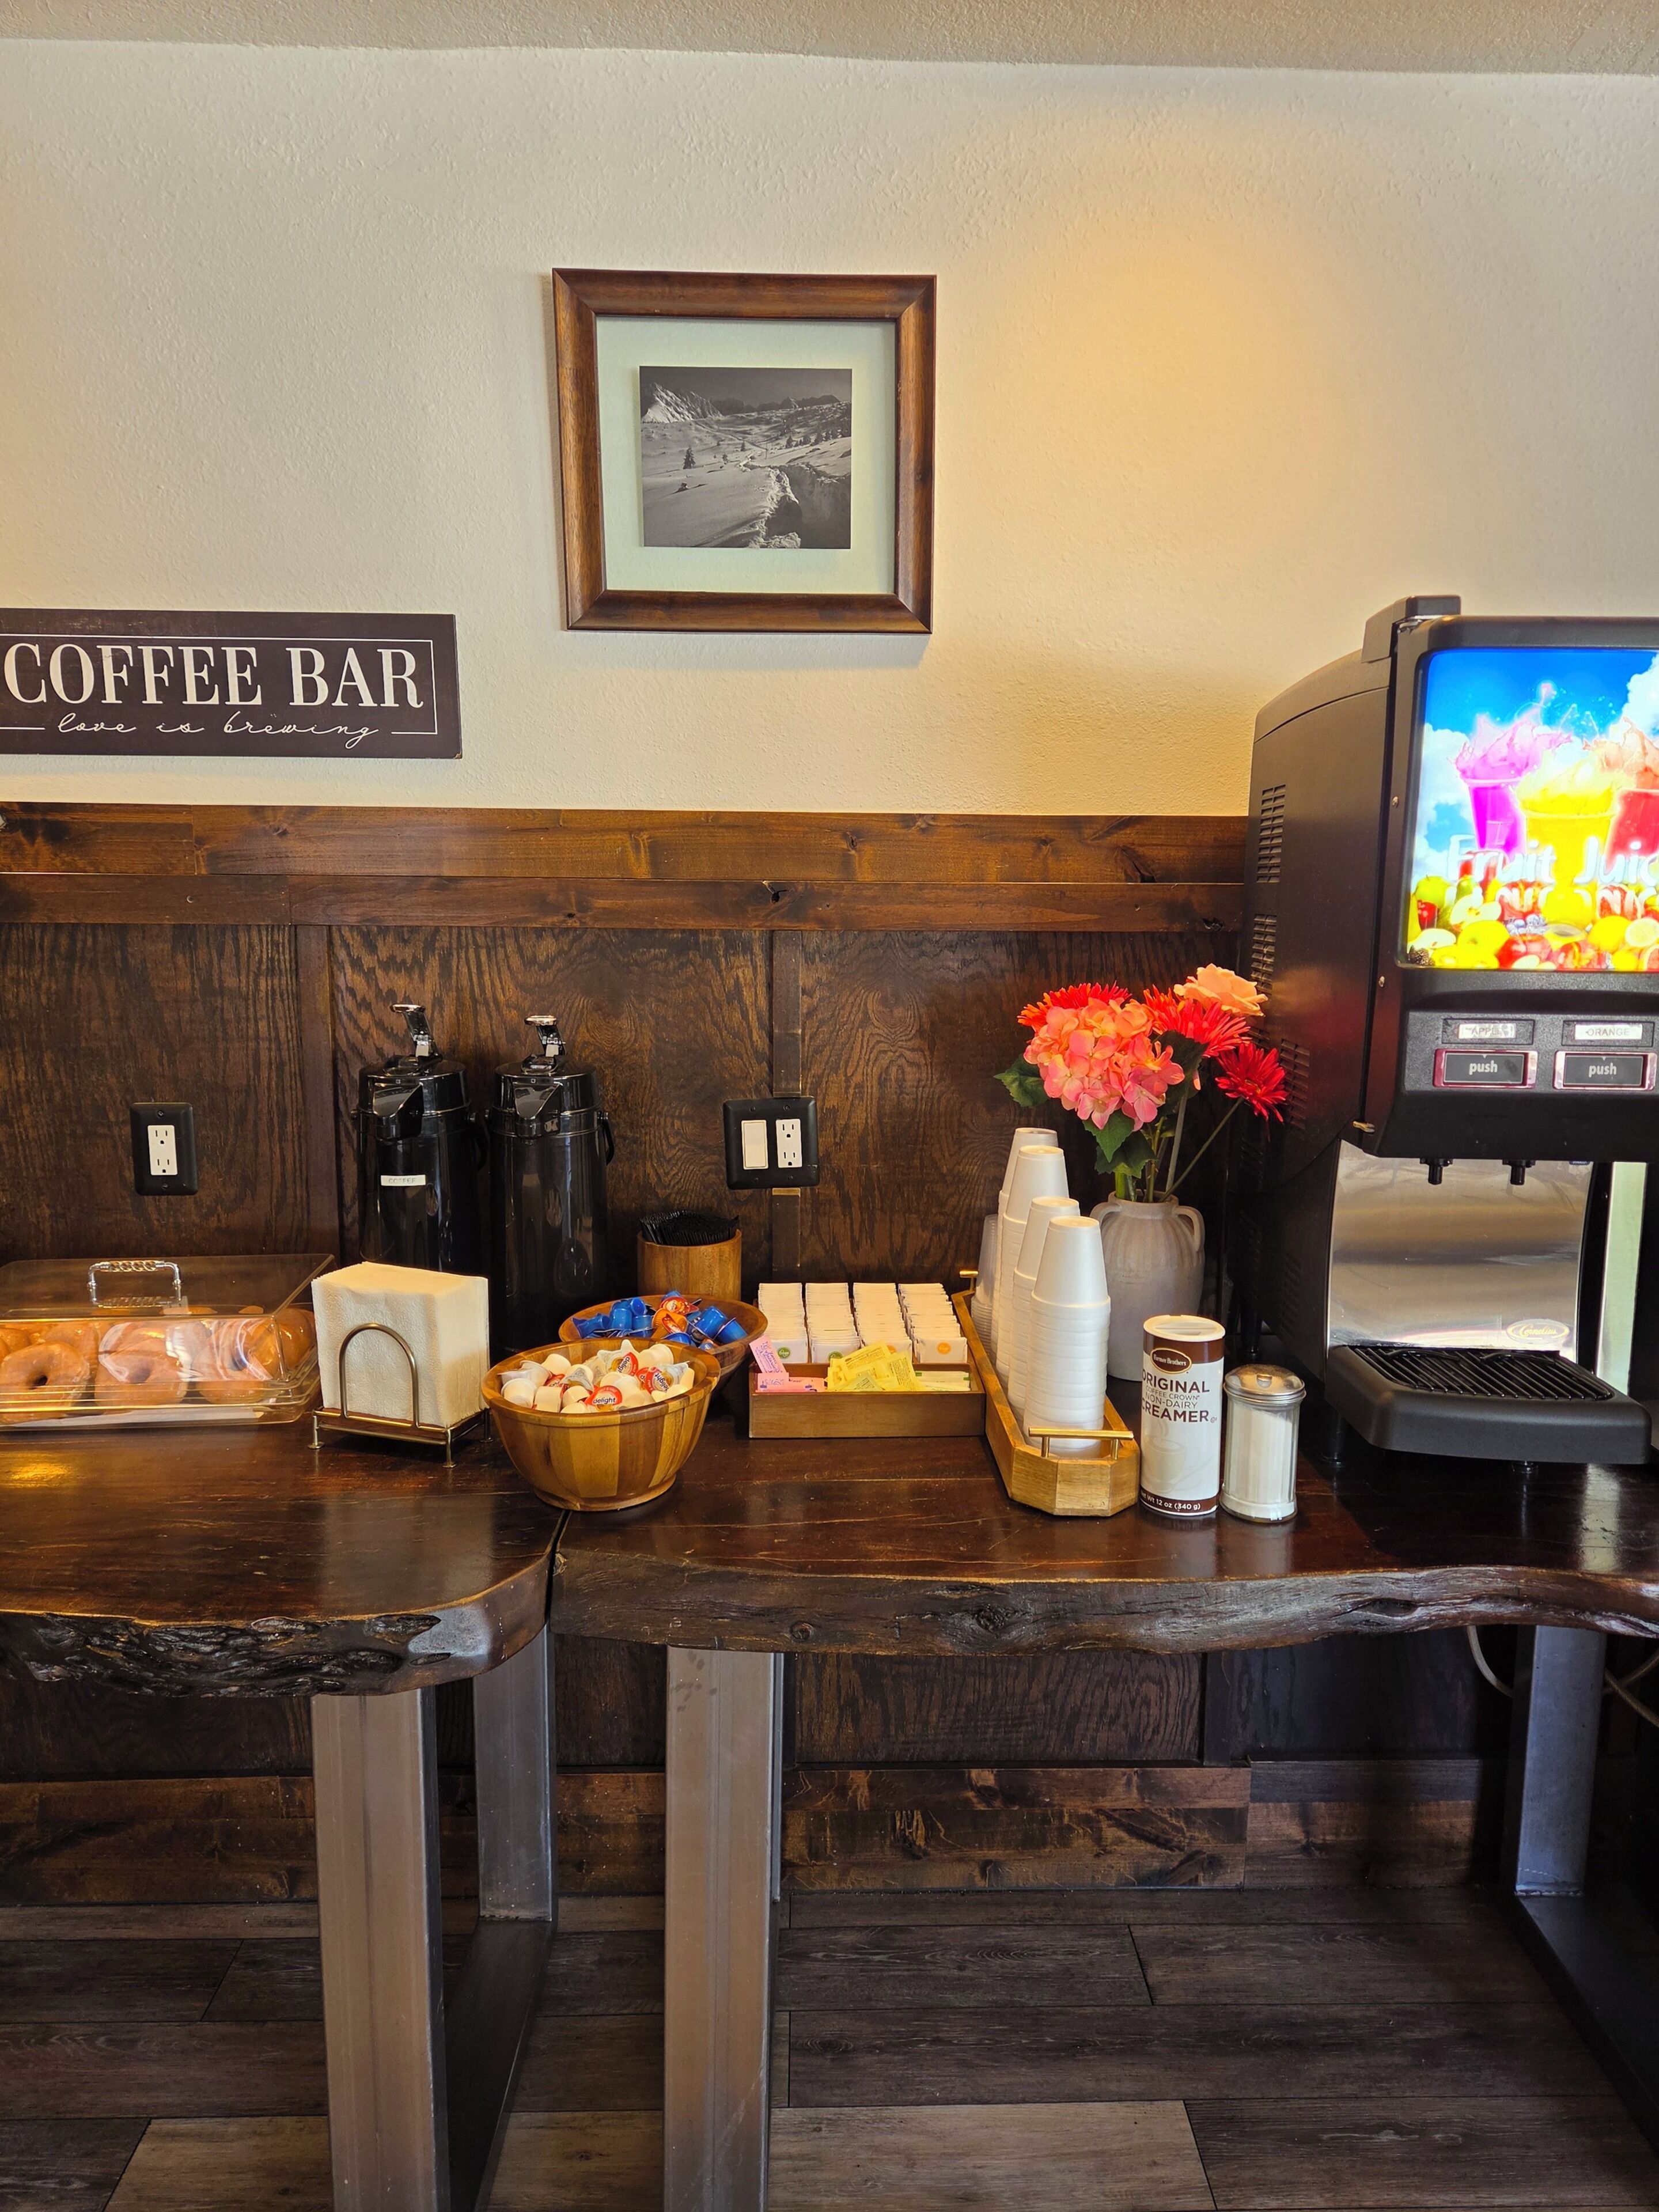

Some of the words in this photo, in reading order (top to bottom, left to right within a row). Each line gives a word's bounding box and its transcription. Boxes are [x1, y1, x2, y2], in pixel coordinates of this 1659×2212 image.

[3, 642, 263, 707] COFFEE
[285, 646, 424, 709] BAR
[58, 712, 137, 734] love
[156, 721, 205, 734] is
[223, 711, 380, 749] brewing
[1447, 834, 1558, 884] Fruit
[1586, 1027, 1630, 1036] ORANGE
[1468, 1060, 1498, 1075] push
[1588, 1062, 1617, 1078] push
[617, 1356, 630, 1373] delig
[1153, 1354, 1166, 1363] Farmer
[1167, 1357, 1187, 1366] Brothers
[1145, 1385, 1167, 1398] COFFEE
[593, 1397, 616, 1405] delight
[1145, 1391, 1198, 1409] NON-DAIRY
[1174, 1502, 1192, 1510] (340
[1193, 1503, 1201, 1511] g)
